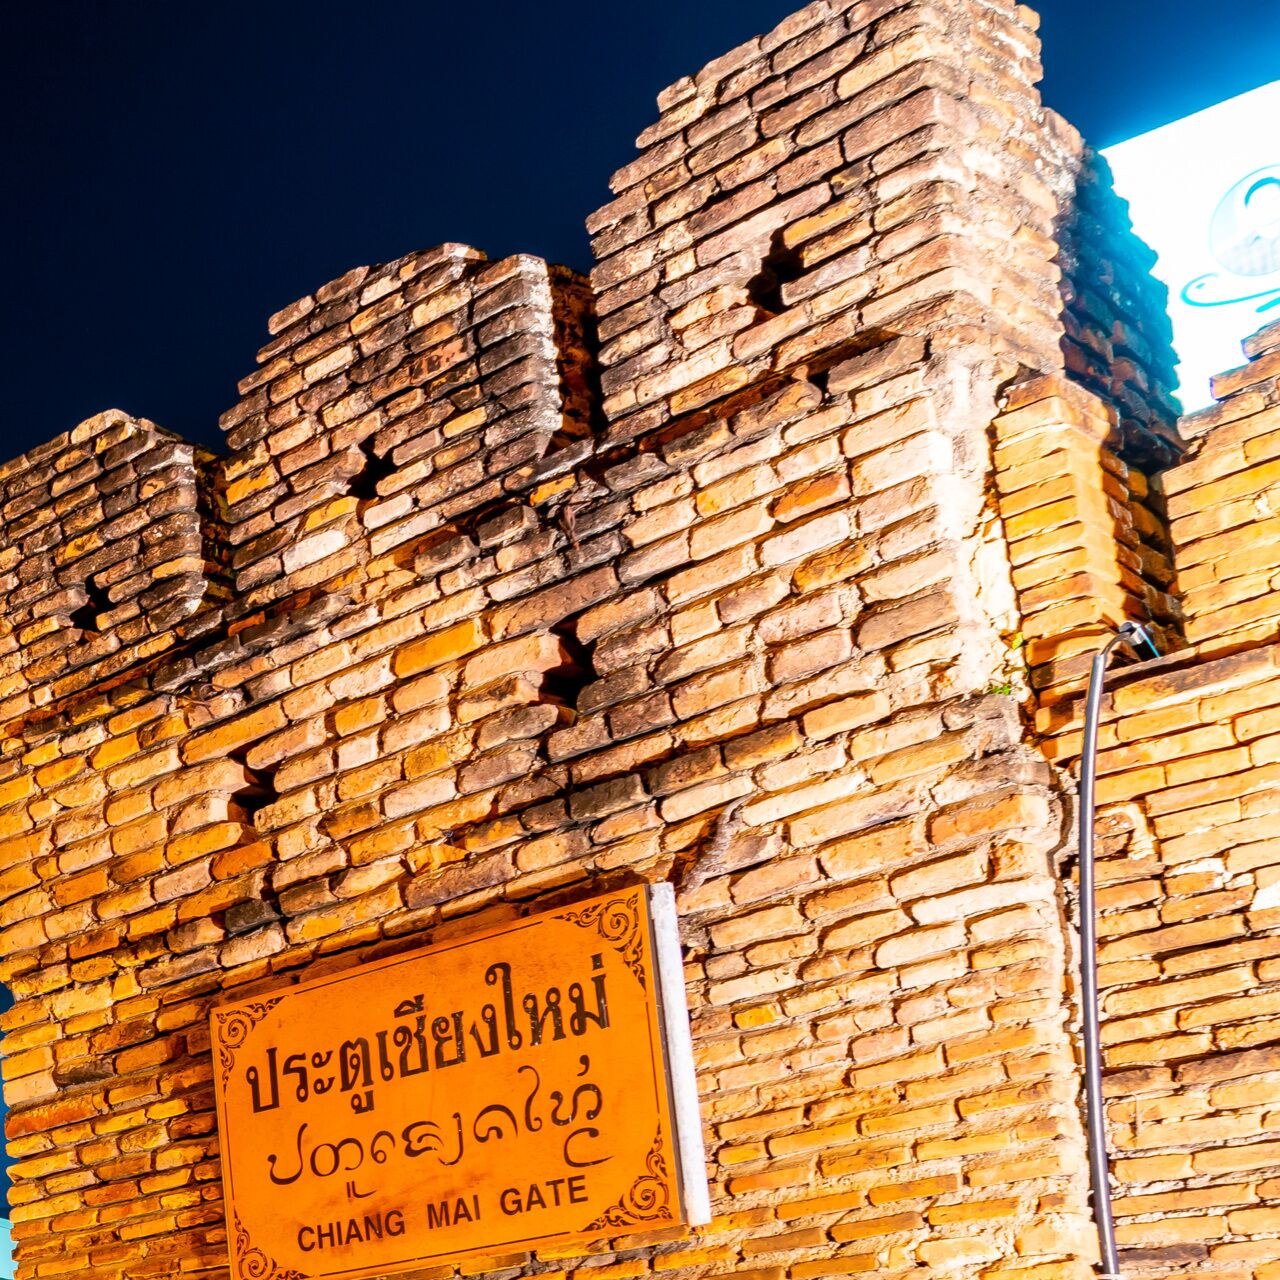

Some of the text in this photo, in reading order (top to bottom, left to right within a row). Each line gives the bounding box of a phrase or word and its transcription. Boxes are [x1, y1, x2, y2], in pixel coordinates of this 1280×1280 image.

[245, 953, 611, 1114] ประตูเชียงใหม่
[297, 1174, 589, 1252] CHIANG MAI GATE
